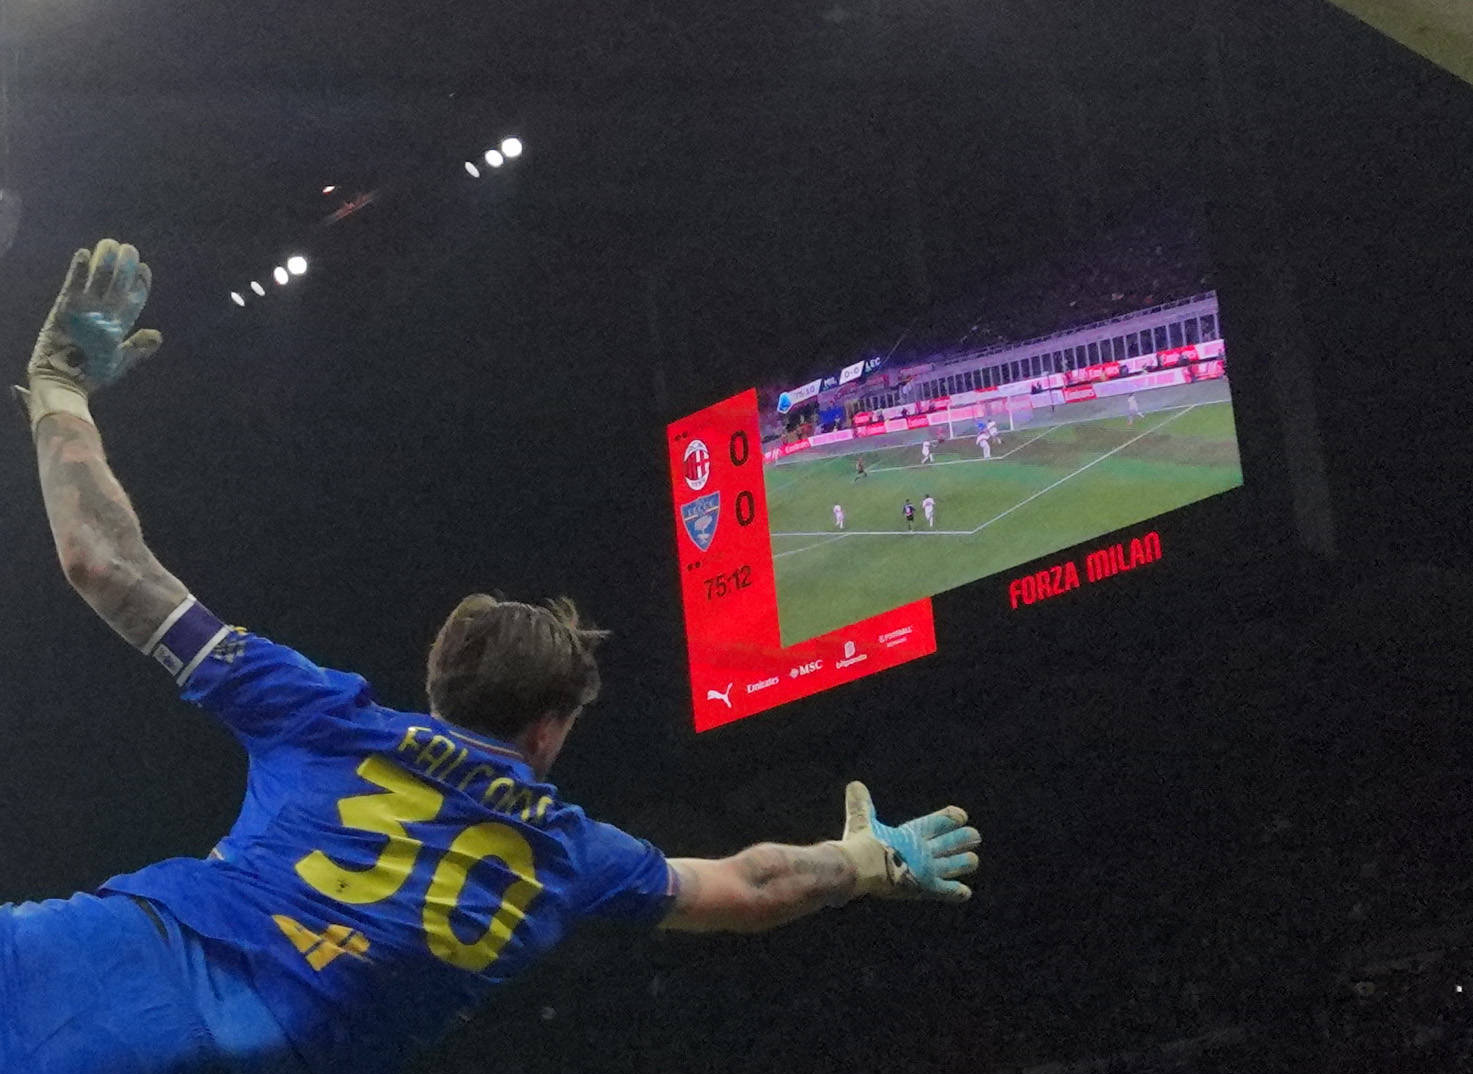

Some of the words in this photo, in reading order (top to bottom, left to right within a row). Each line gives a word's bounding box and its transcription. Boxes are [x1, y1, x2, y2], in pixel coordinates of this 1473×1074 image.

[730, 430, 749, 467] 0
[735, 490, 755, 527] 0
[704, 565, 753, 601] 75:12
[1009, 556, 1080, 609] FORZA
[1086, 531, 1162, 582] MILAN
[294, 755, 544, 972] 30
